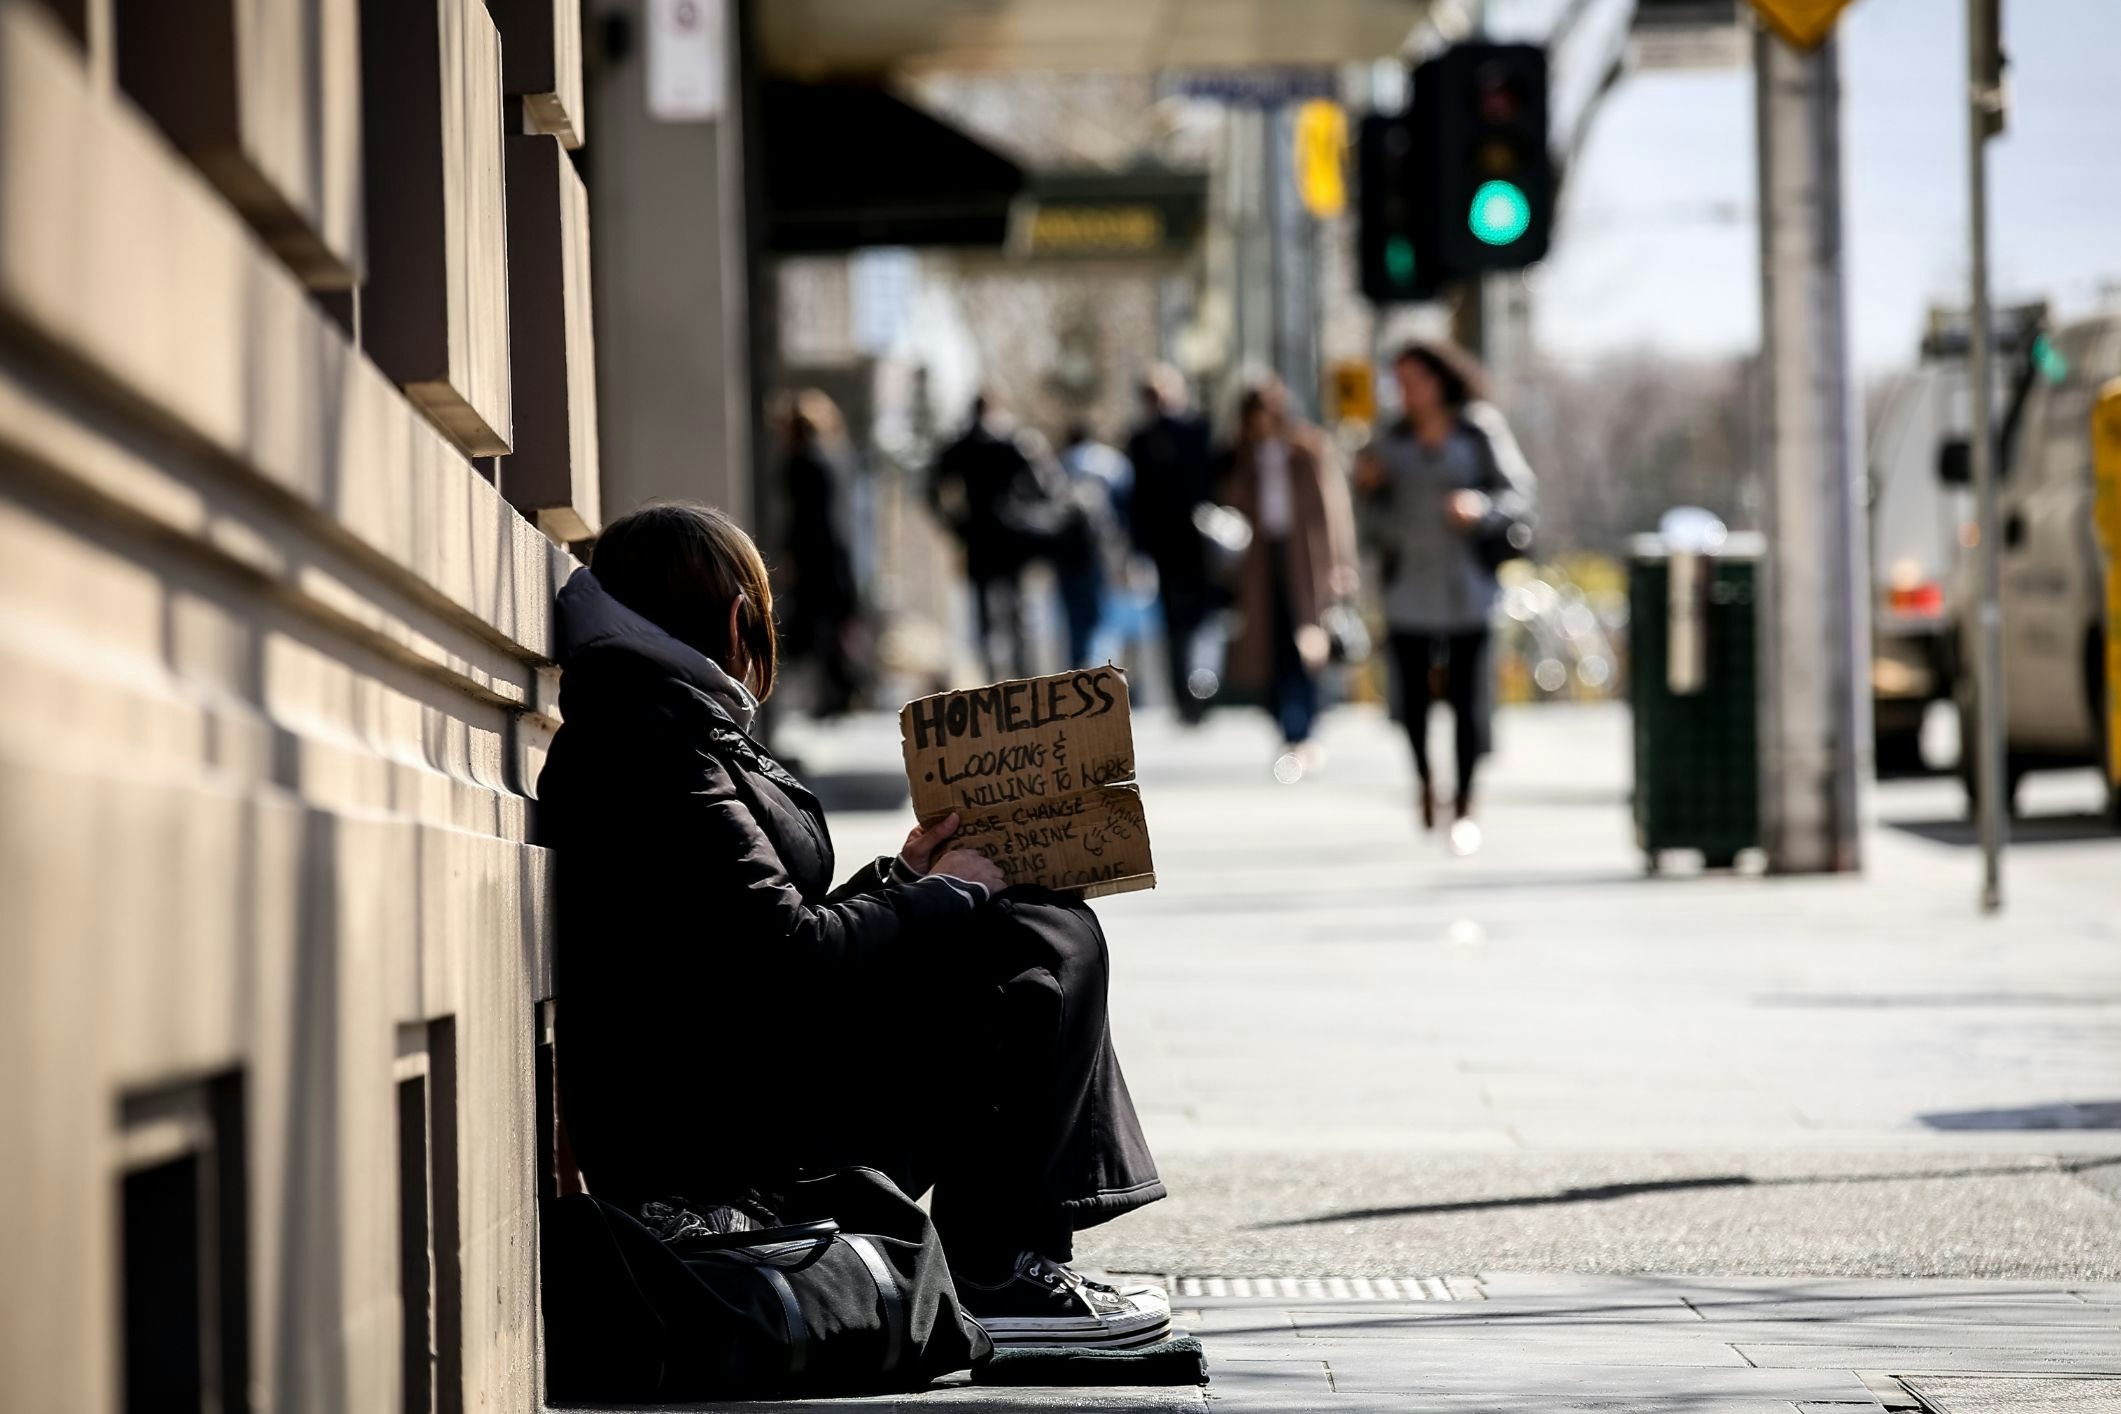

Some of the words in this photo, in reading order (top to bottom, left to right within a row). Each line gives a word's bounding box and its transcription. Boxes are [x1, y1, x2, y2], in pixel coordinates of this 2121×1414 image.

[912, 673, 1114, 749] HOMELESS
[939, 742, 1047, 785] LOOKING
[1052, 730, 1067, 766] &
[962, 774, 1047, 810] WILLING
[1052, 768, 1071, 791] TO
[1081, 758, 1130, 787] WORK
[1012, 797, 1086, 824] CHANGE
[1014, 821, 1078, 852] DRINK
